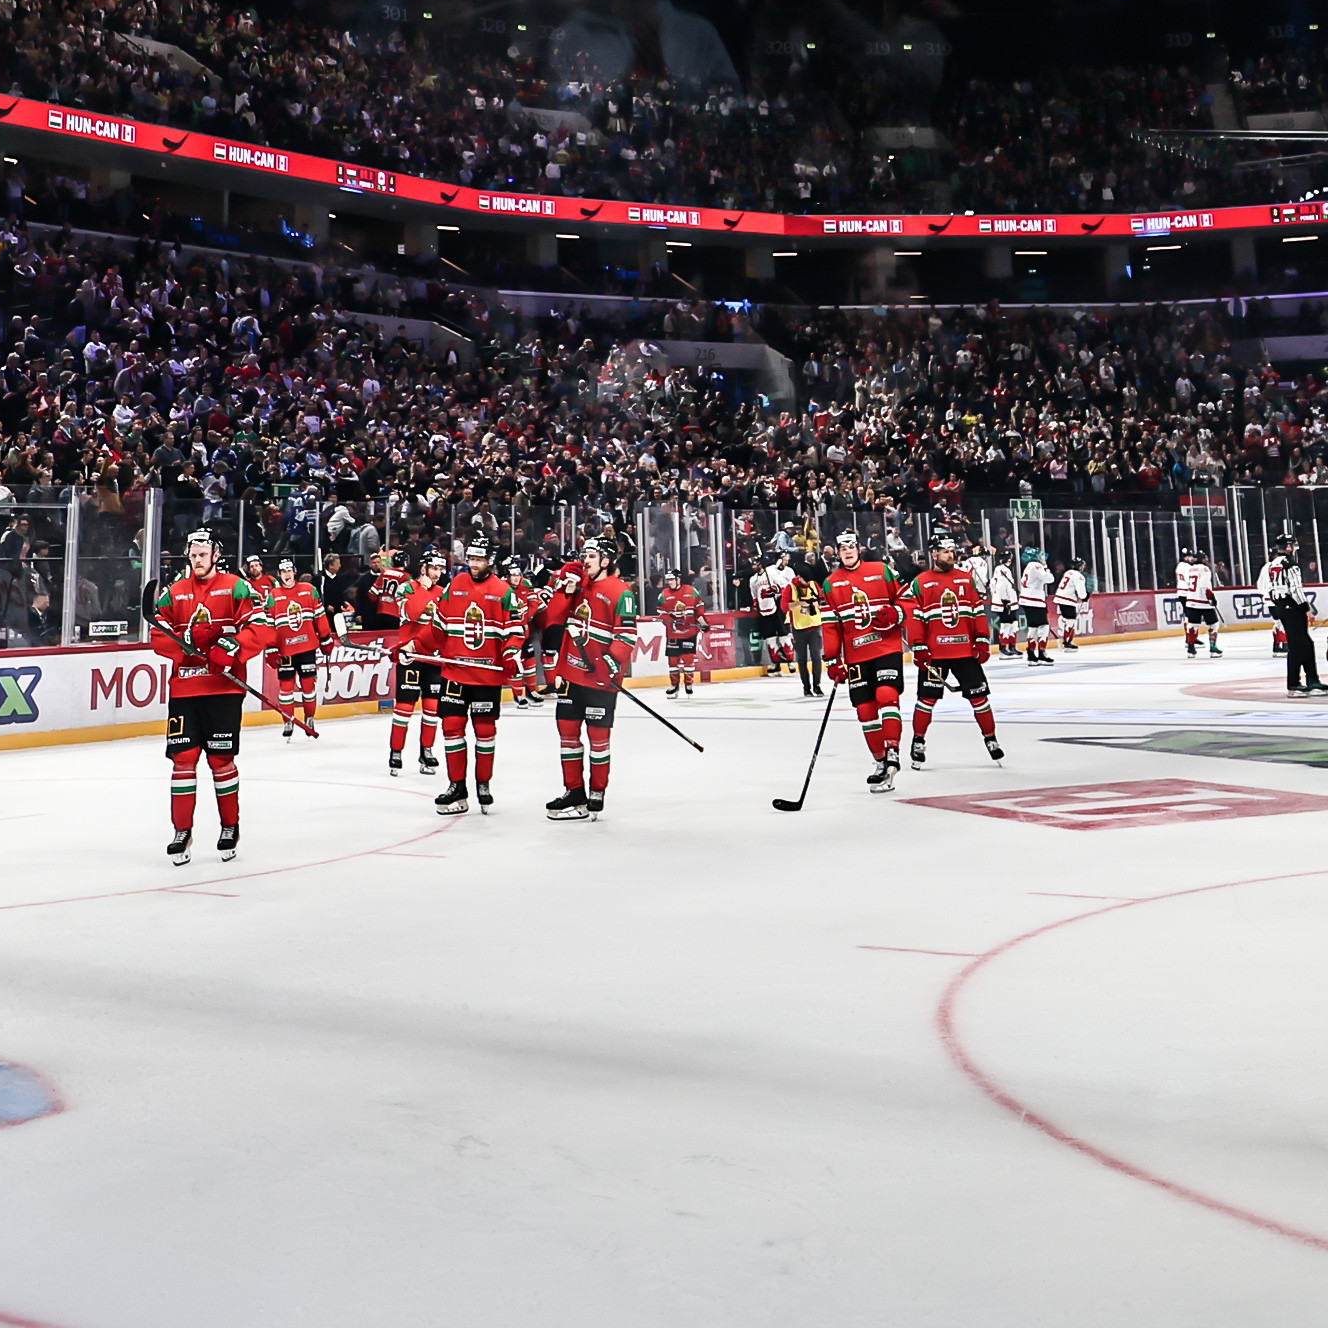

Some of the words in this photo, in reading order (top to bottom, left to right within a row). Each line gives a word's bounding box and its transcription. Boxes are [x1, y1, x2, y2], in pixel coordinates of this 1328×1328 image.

[380, 4, 409, 23] 301
[478, 17, 507, 34] 320
[1164, 32, 1193, 49] 319
[65, 112, 120, 140] HUN-CAN
[228, 145, 275, 170] HUN-CAN
[492, 195, 541, 215] HUN-CAN
[642, 207, 688, 226] HUN-CAN
[993, 218, 1042, 234] HUN-CAN
[1146, 213, 1198, 232] HUN-CAN
[838, 219, 888, 234] HUN-CAN
[695, 347, 717, 361] 216
